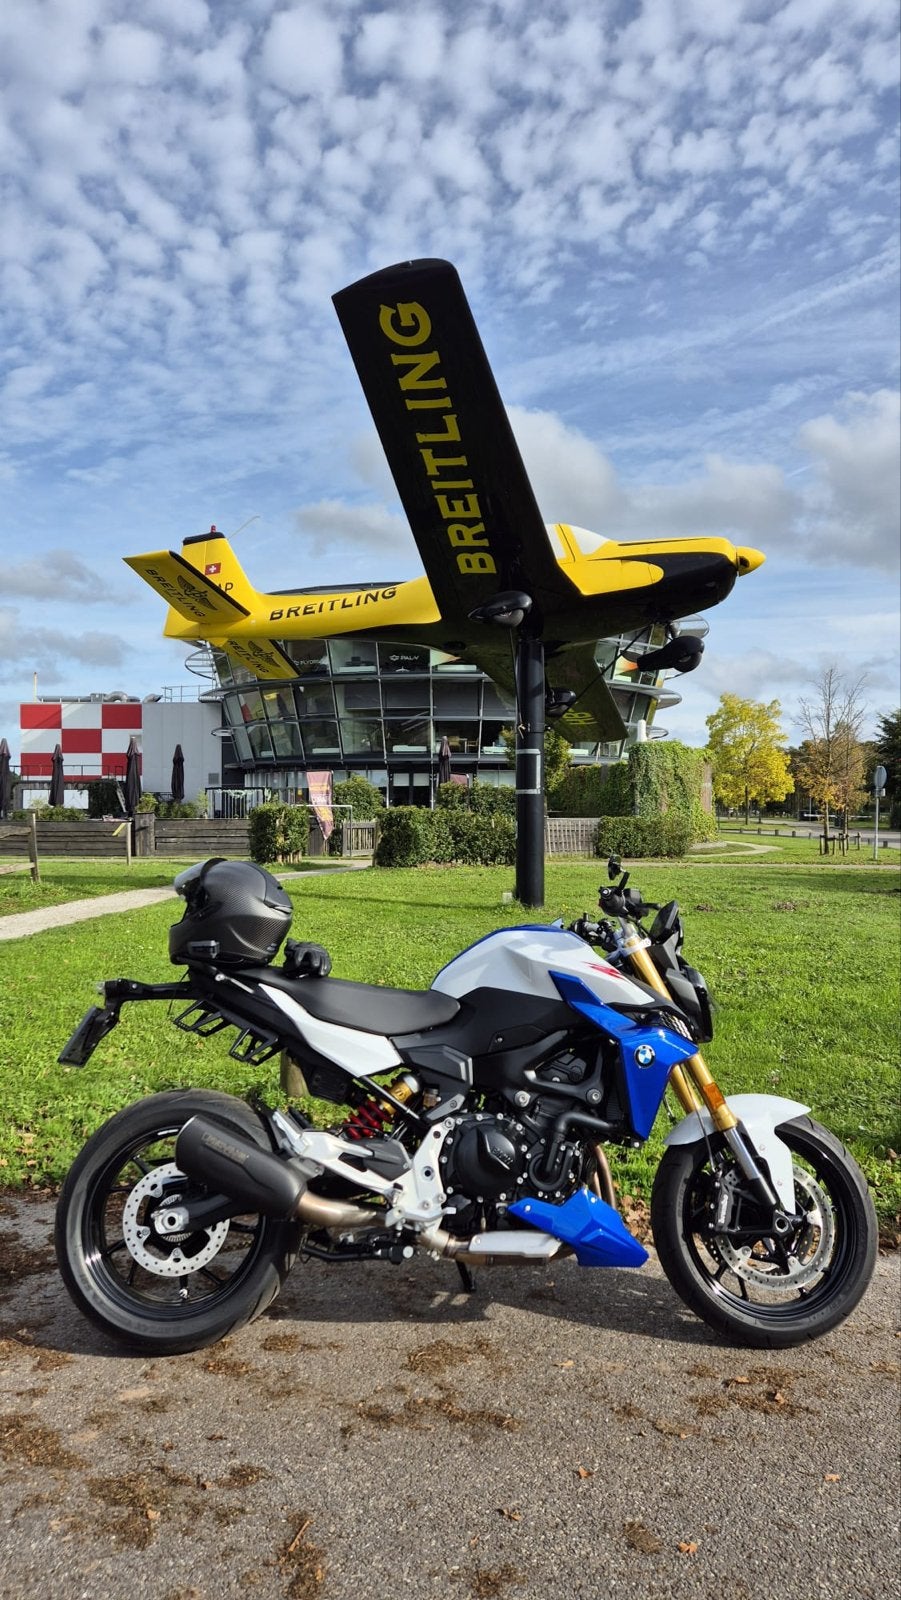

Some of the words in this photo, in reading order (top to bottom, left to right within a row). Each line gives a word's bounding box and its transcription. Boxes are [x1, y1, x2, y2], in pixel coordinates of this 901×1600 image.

[379, 301, 497, 574] BREITLING
[145, 568, 206, 618] BREITLING
[269, 587, 397, 621] BREITLING
[228, 640, 270, 673] REITLING
